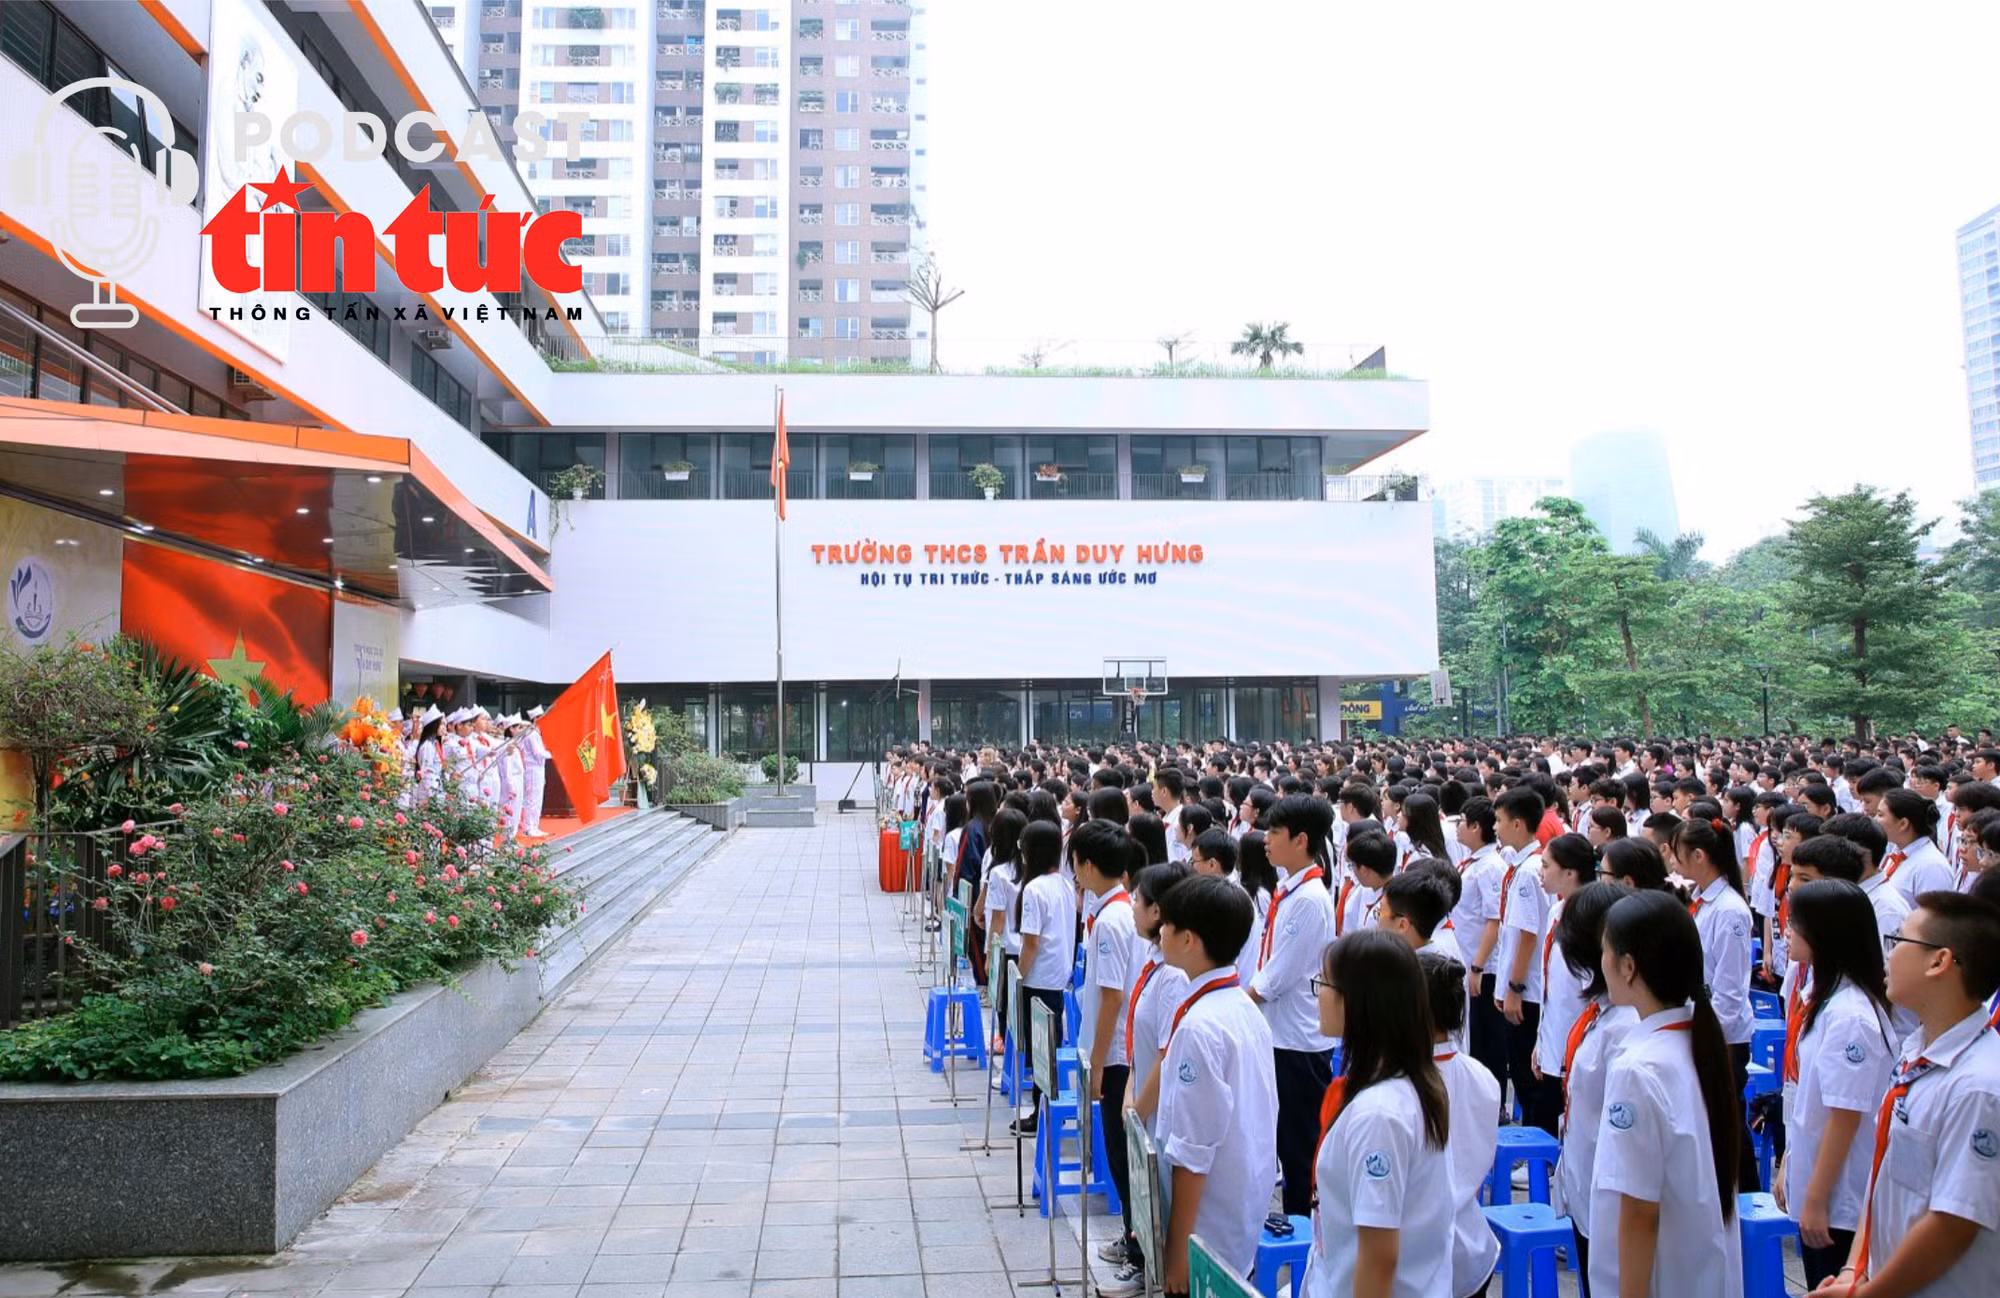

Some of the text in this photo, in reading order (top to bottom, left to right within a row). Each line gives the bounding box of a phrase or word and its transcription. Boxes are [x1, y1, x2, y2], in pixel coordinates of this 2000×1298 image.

[526, 488, 538, 539] A
[811, 538, 913, 565] TRƯỜNG
[924, 544, 988, 565] THCS
[1076, 544, 1125, 565] DUY
[1137, 541, 1204, 565] HƯNG
[860, 572, 886, 588] HỘI
[893, 572, 912, 588] TỤ
[920, 572, 945, 586] TRI
[951, 570, 990, 586] THỨC
[1051, 570, 1093, 586] SÁNG
[1098, 568, 1127, 586] ƯỚC
[1134, 571, 1158, 586] MƠ
